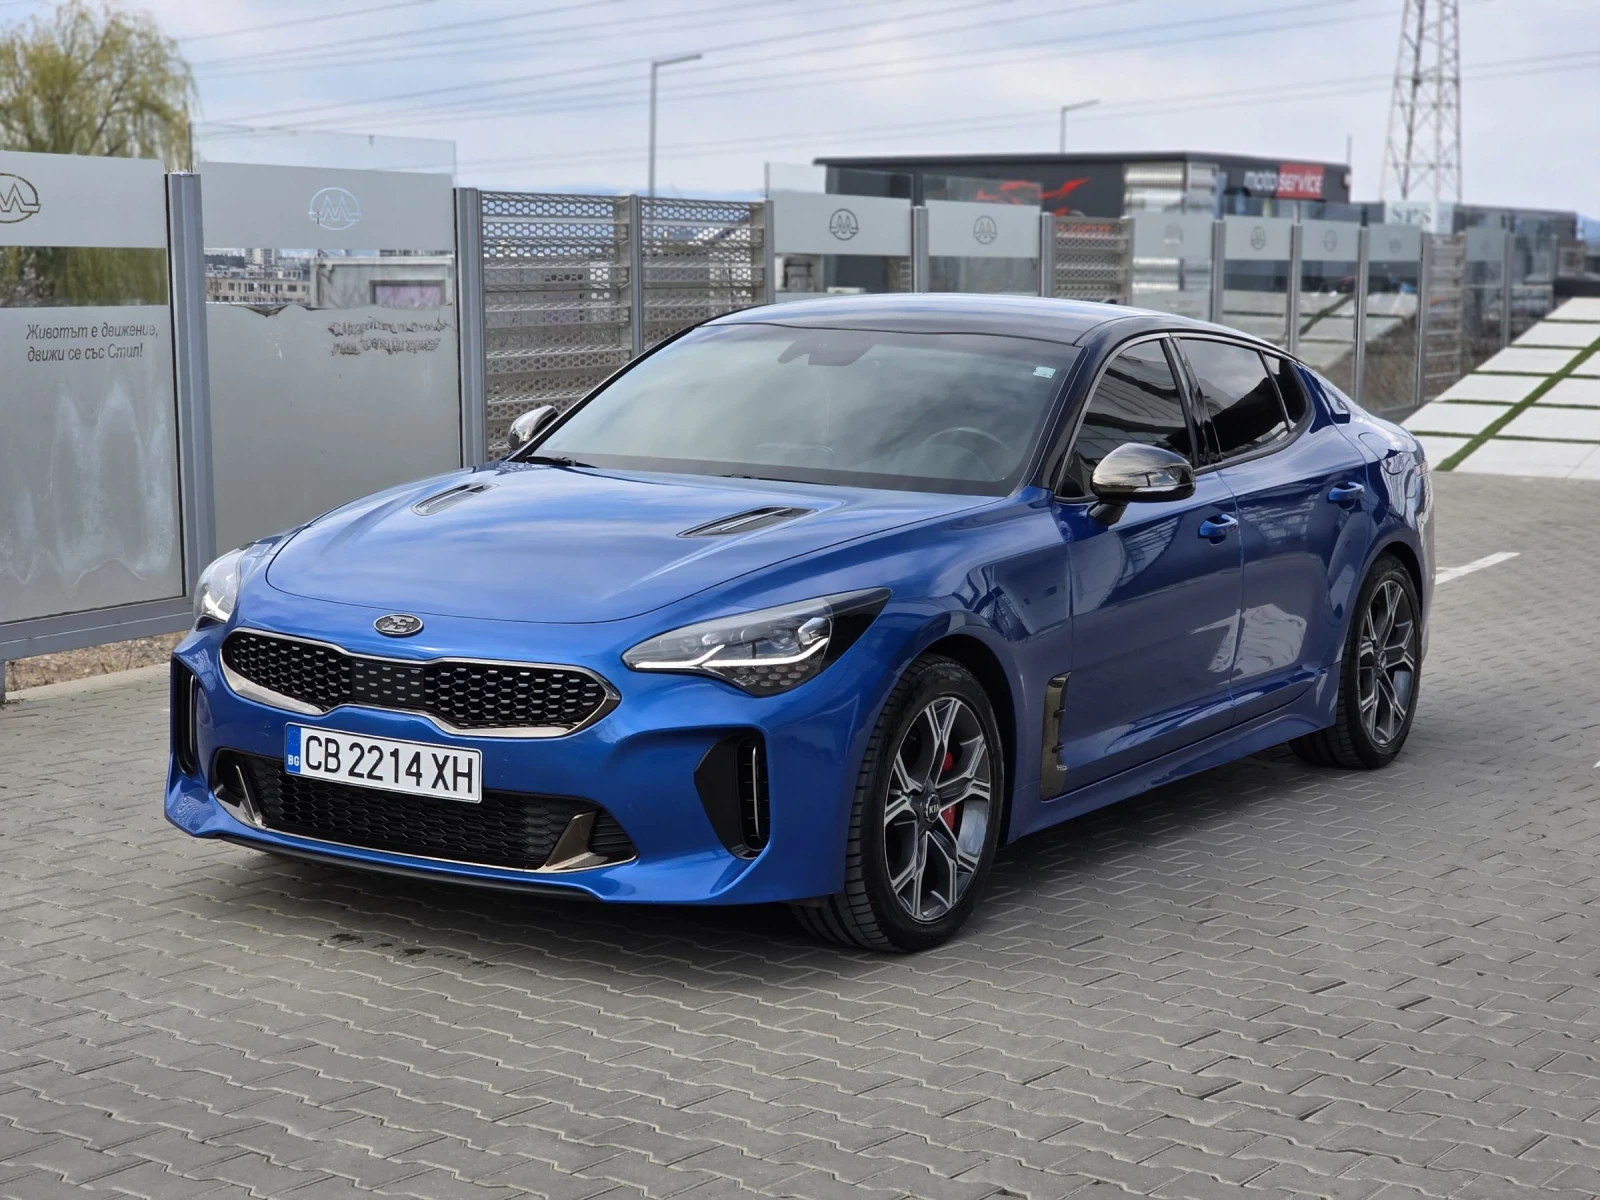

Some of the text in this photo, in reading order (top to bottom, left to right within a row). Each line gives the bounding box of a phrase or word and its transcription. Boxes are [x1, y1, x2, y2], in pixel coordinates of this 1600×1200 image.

[26, 322, 158, 340] Животът е движение,
[27, 342, 143, 362] движи се със Стил!
[288, 755, 299, 766] BG
[305, 736, 472, 793] CB 2214 XH
